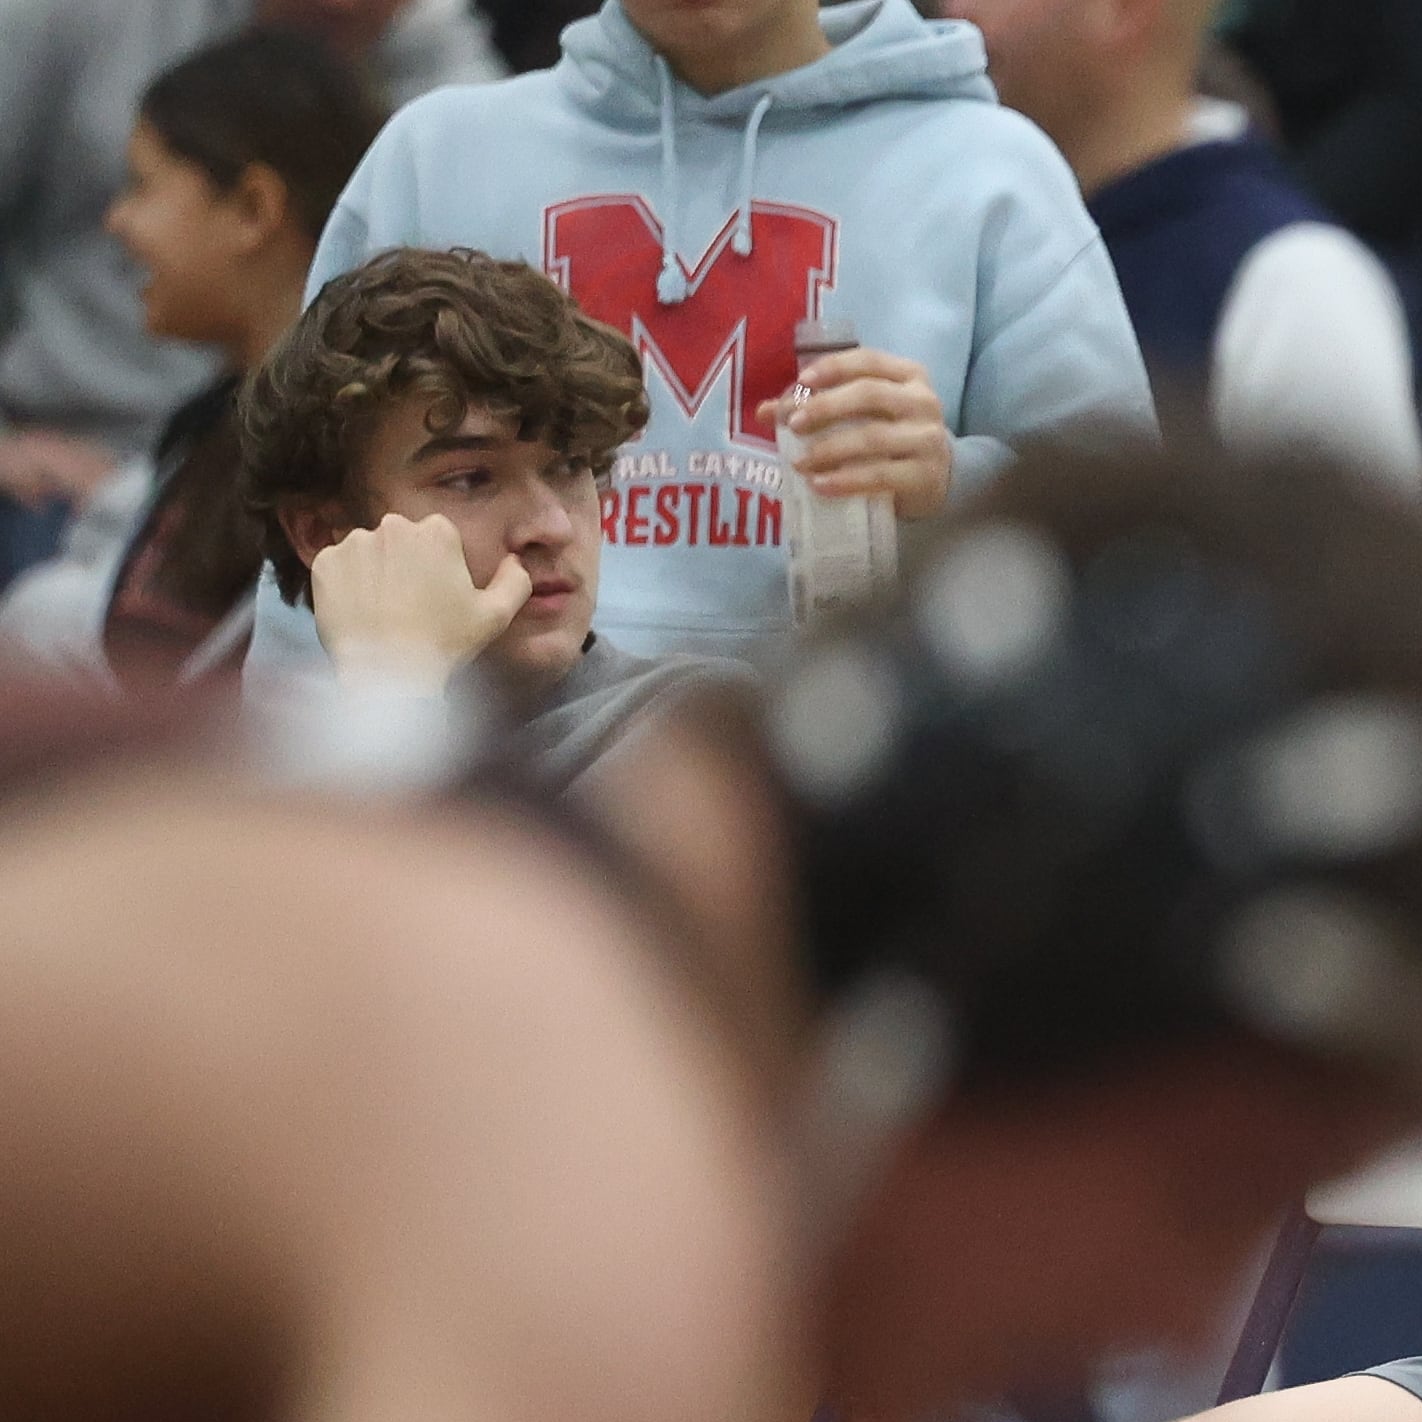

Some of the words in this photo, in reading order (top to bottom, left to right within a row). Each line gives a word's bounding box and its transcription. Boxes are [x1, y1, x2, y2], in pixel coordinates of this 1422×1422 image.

[540, 192, 838, 455] M
[688, 453, 785, 490] CATHO
[600, 483, 784, 547] RESTLIN
